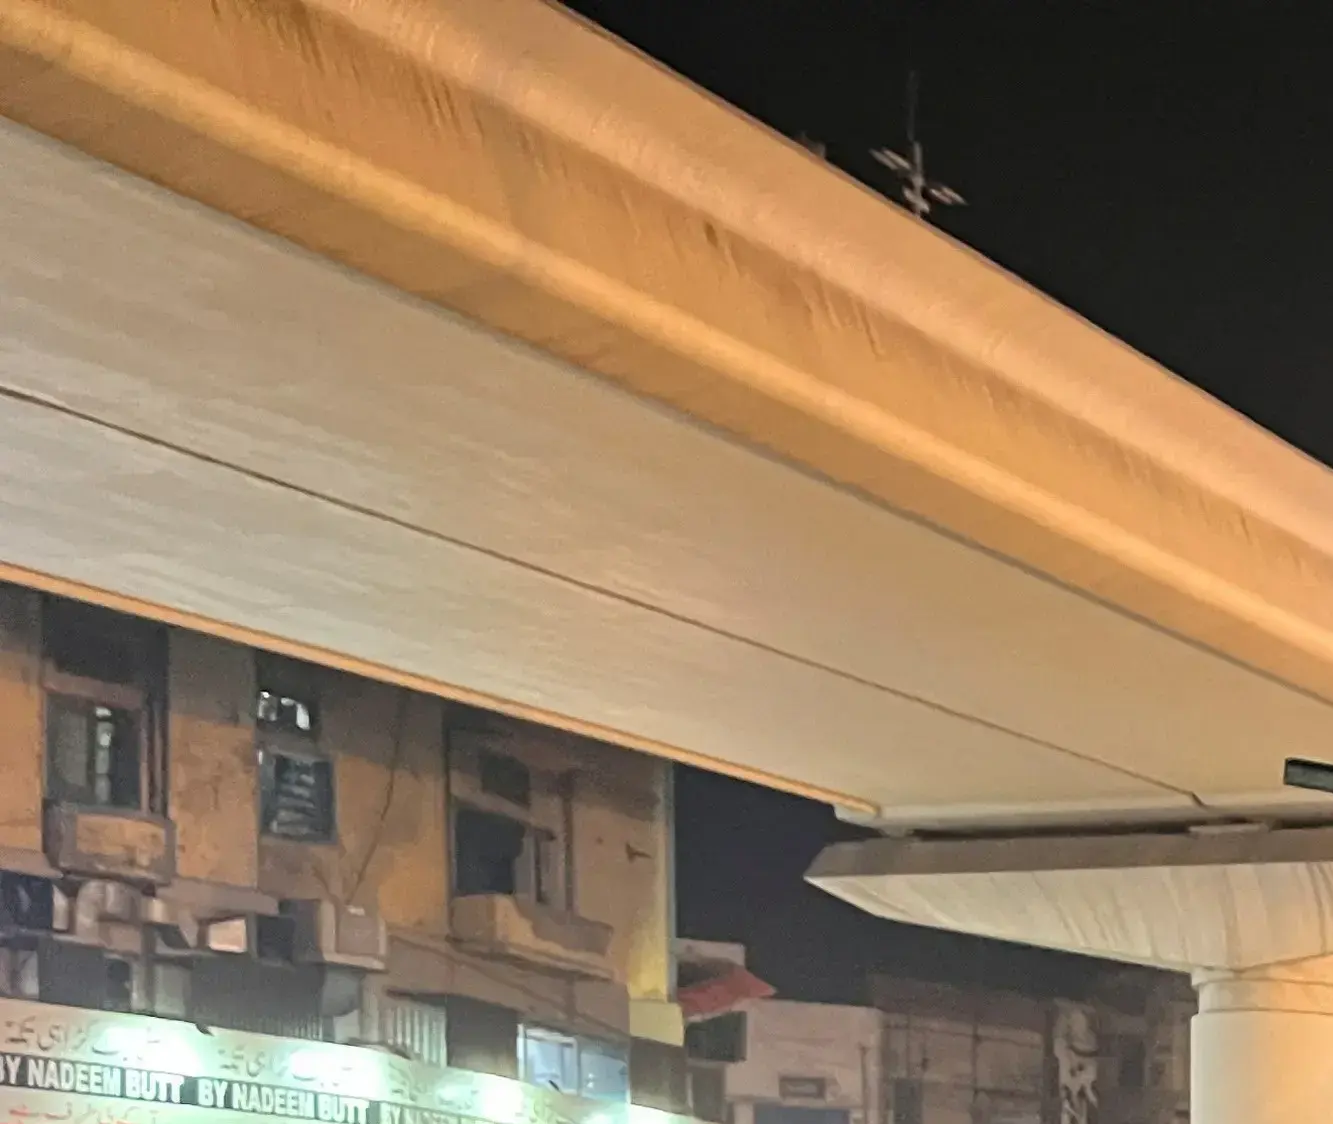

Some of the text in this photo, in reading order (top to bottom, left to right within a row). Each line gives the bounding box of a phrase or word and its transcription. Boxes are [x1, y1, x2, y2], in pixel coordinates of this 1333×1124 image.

[0, 1055, 21, 1085] Y
[27, 1059, 122, 1097] NADEEM
[125, 1067, 185, 1104] BUTT
[197, 1078, 228, 1108] BY
[232, 1082, 316, 1118] NADEEM
